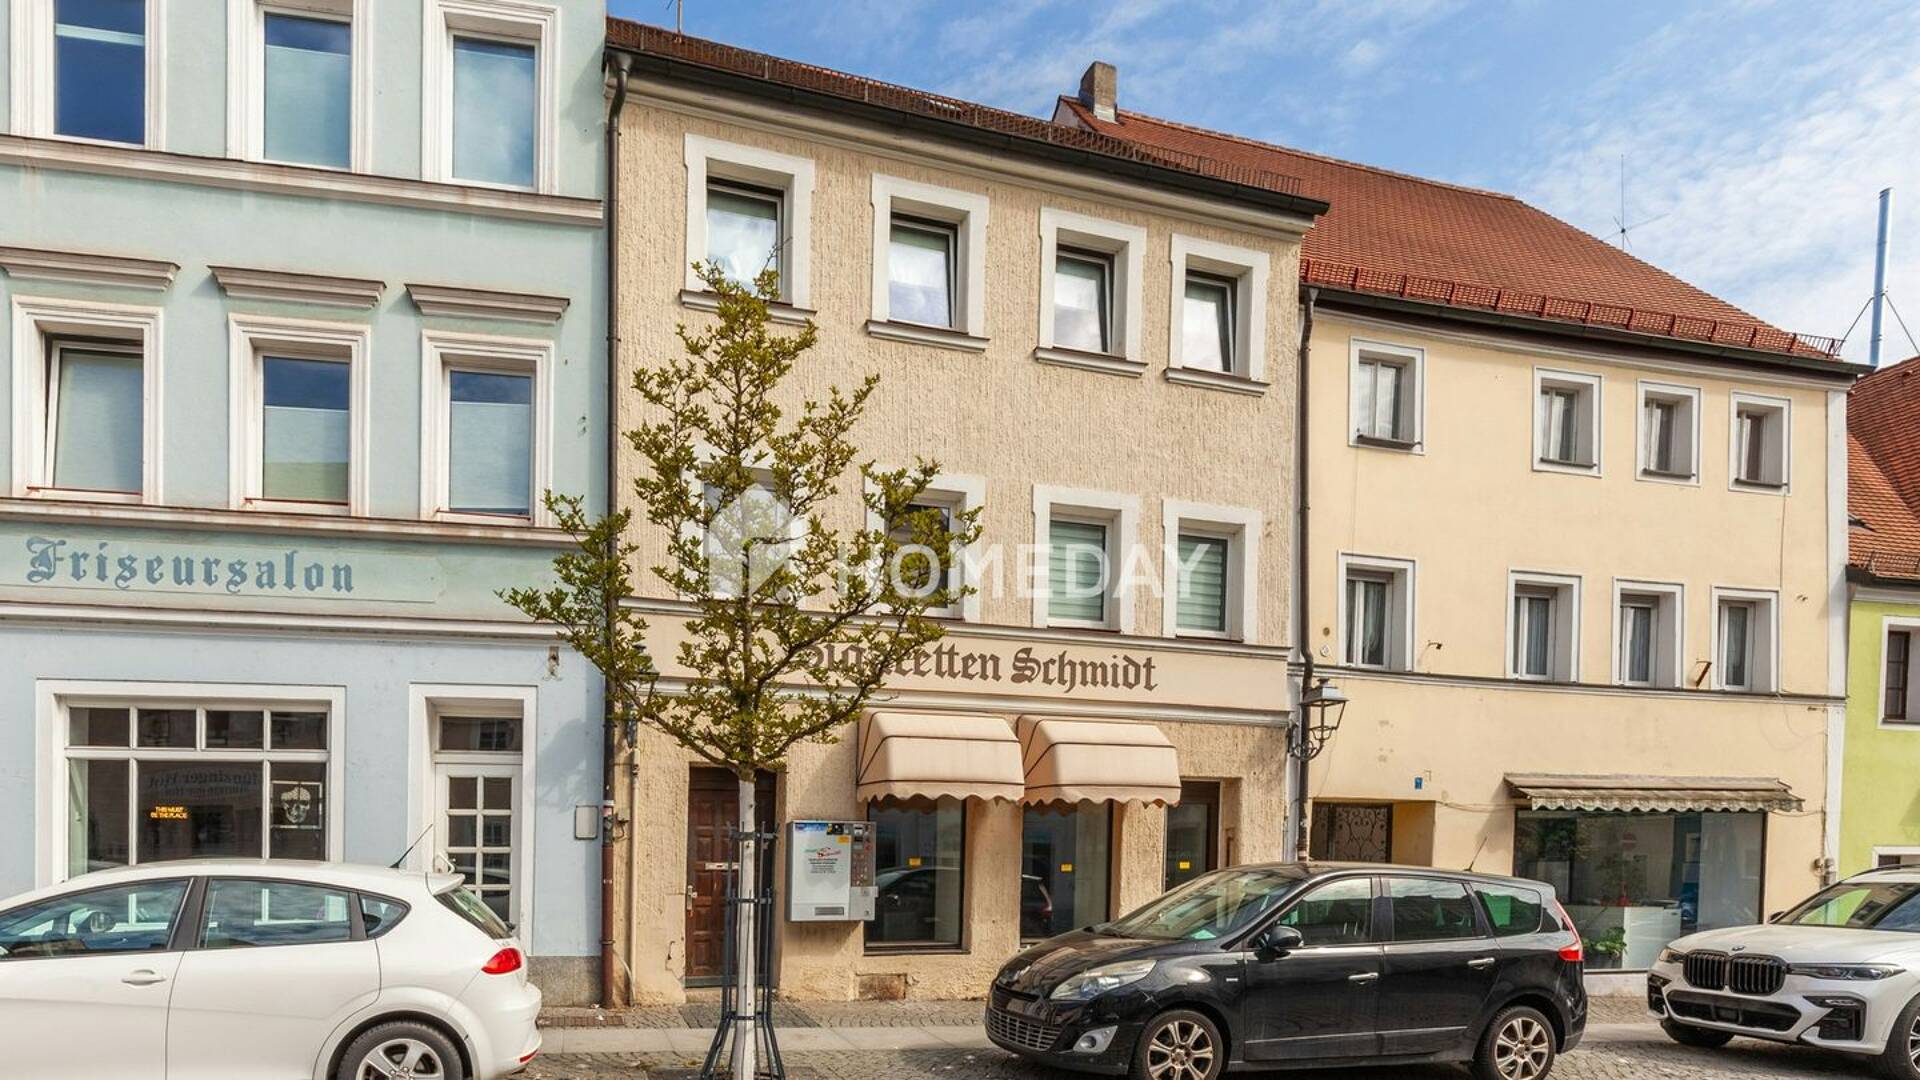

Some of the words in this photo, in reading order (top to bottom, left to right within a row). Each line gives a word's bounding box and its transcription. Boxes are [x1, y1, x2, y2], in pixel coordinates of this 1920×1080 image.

[26, 536, 354, 594] Friseursalon
[794, 641, 1002, 682] igretten
[1010, 647, 1159, 694] Schmidt
